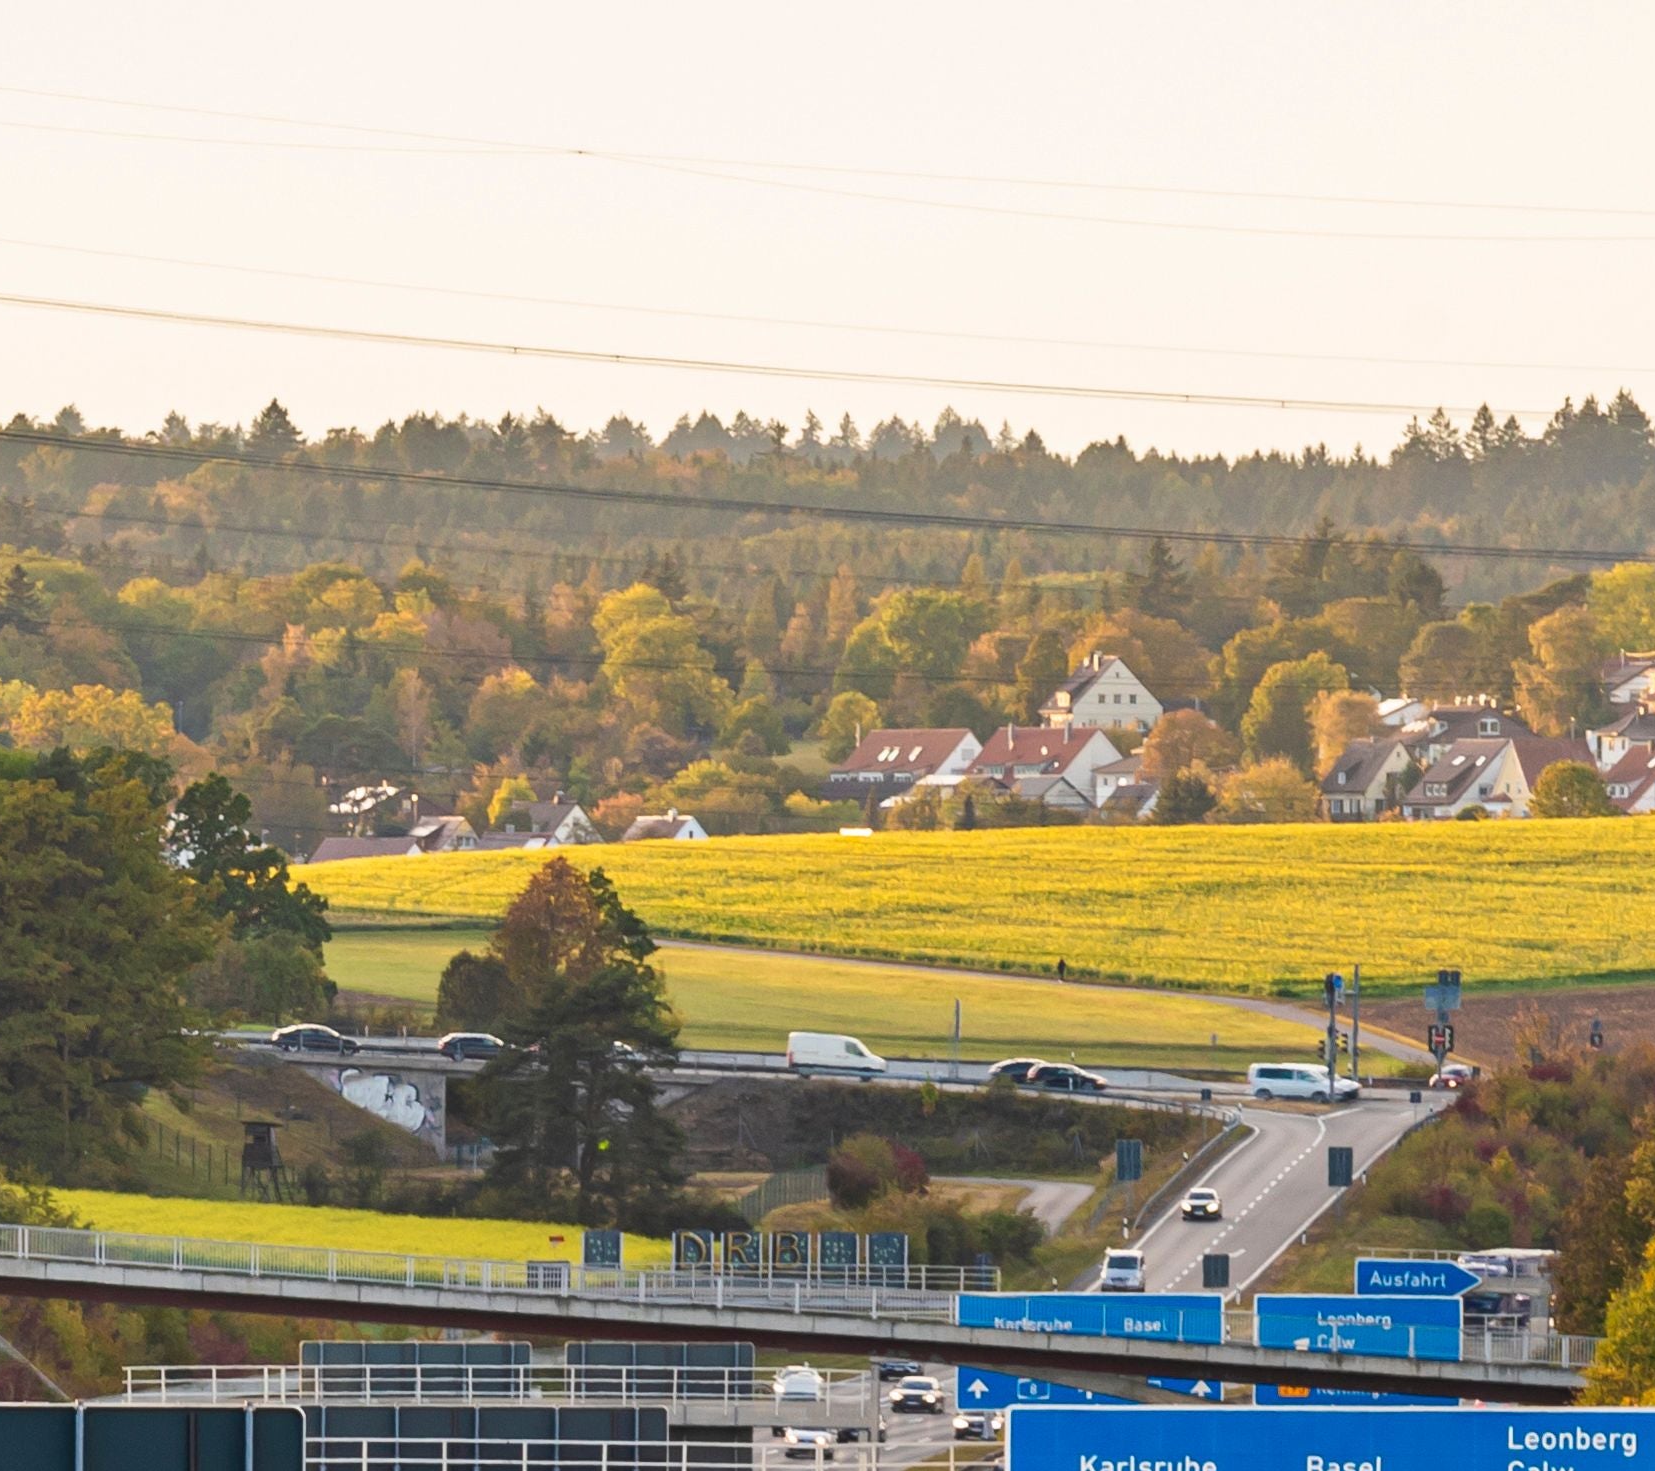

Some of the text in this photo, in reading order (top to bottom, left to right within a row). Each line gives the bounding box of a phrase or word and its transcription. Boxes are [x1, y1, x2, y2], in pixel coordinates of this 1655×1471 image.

[1370, 1270, 1447, 1288] Ausfahrt
[1123, 1318, 1168, 1333] Basel
[1317, 1311, 1392, 1330] Leonberg
[1507, 1426, 1637, 1456] Leonberg
